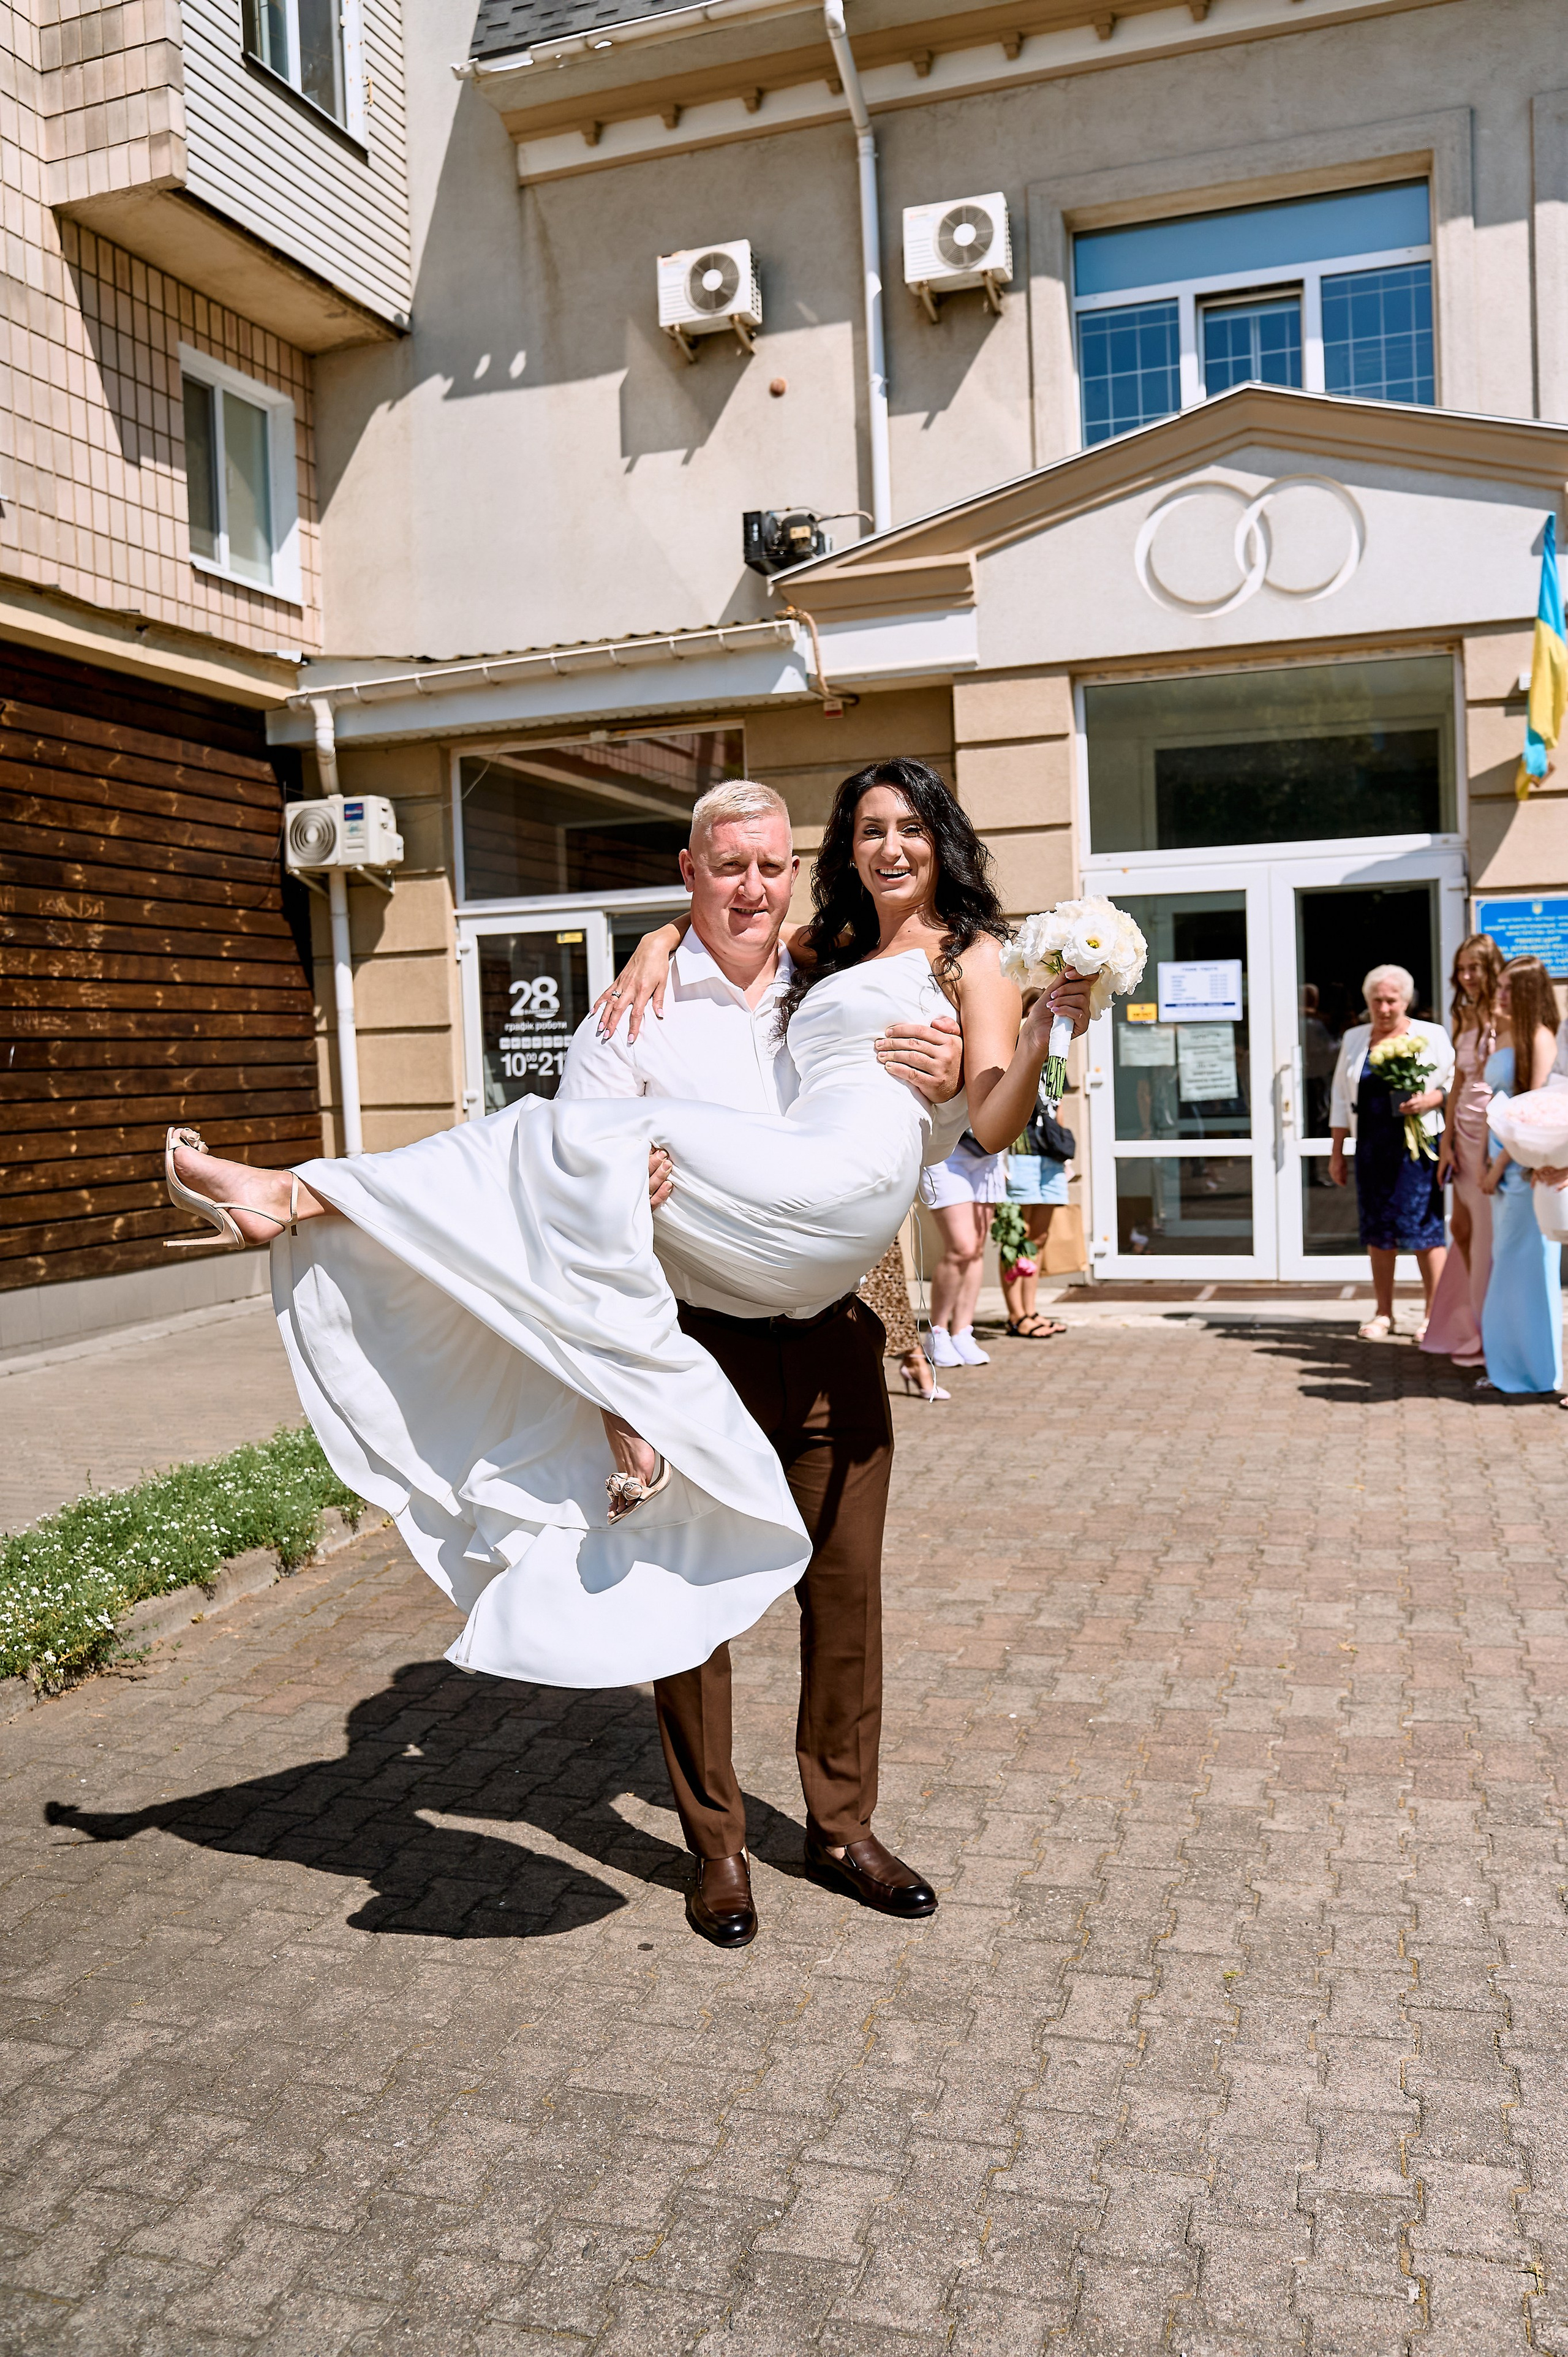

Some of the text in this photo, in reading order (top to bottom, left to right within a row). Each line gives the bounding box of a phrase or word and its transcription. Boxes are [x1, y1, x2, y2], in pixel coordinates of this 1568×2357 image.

[509, 976, 560, 1019] 28
[505, 1020, 567, 1033] графік роботи
